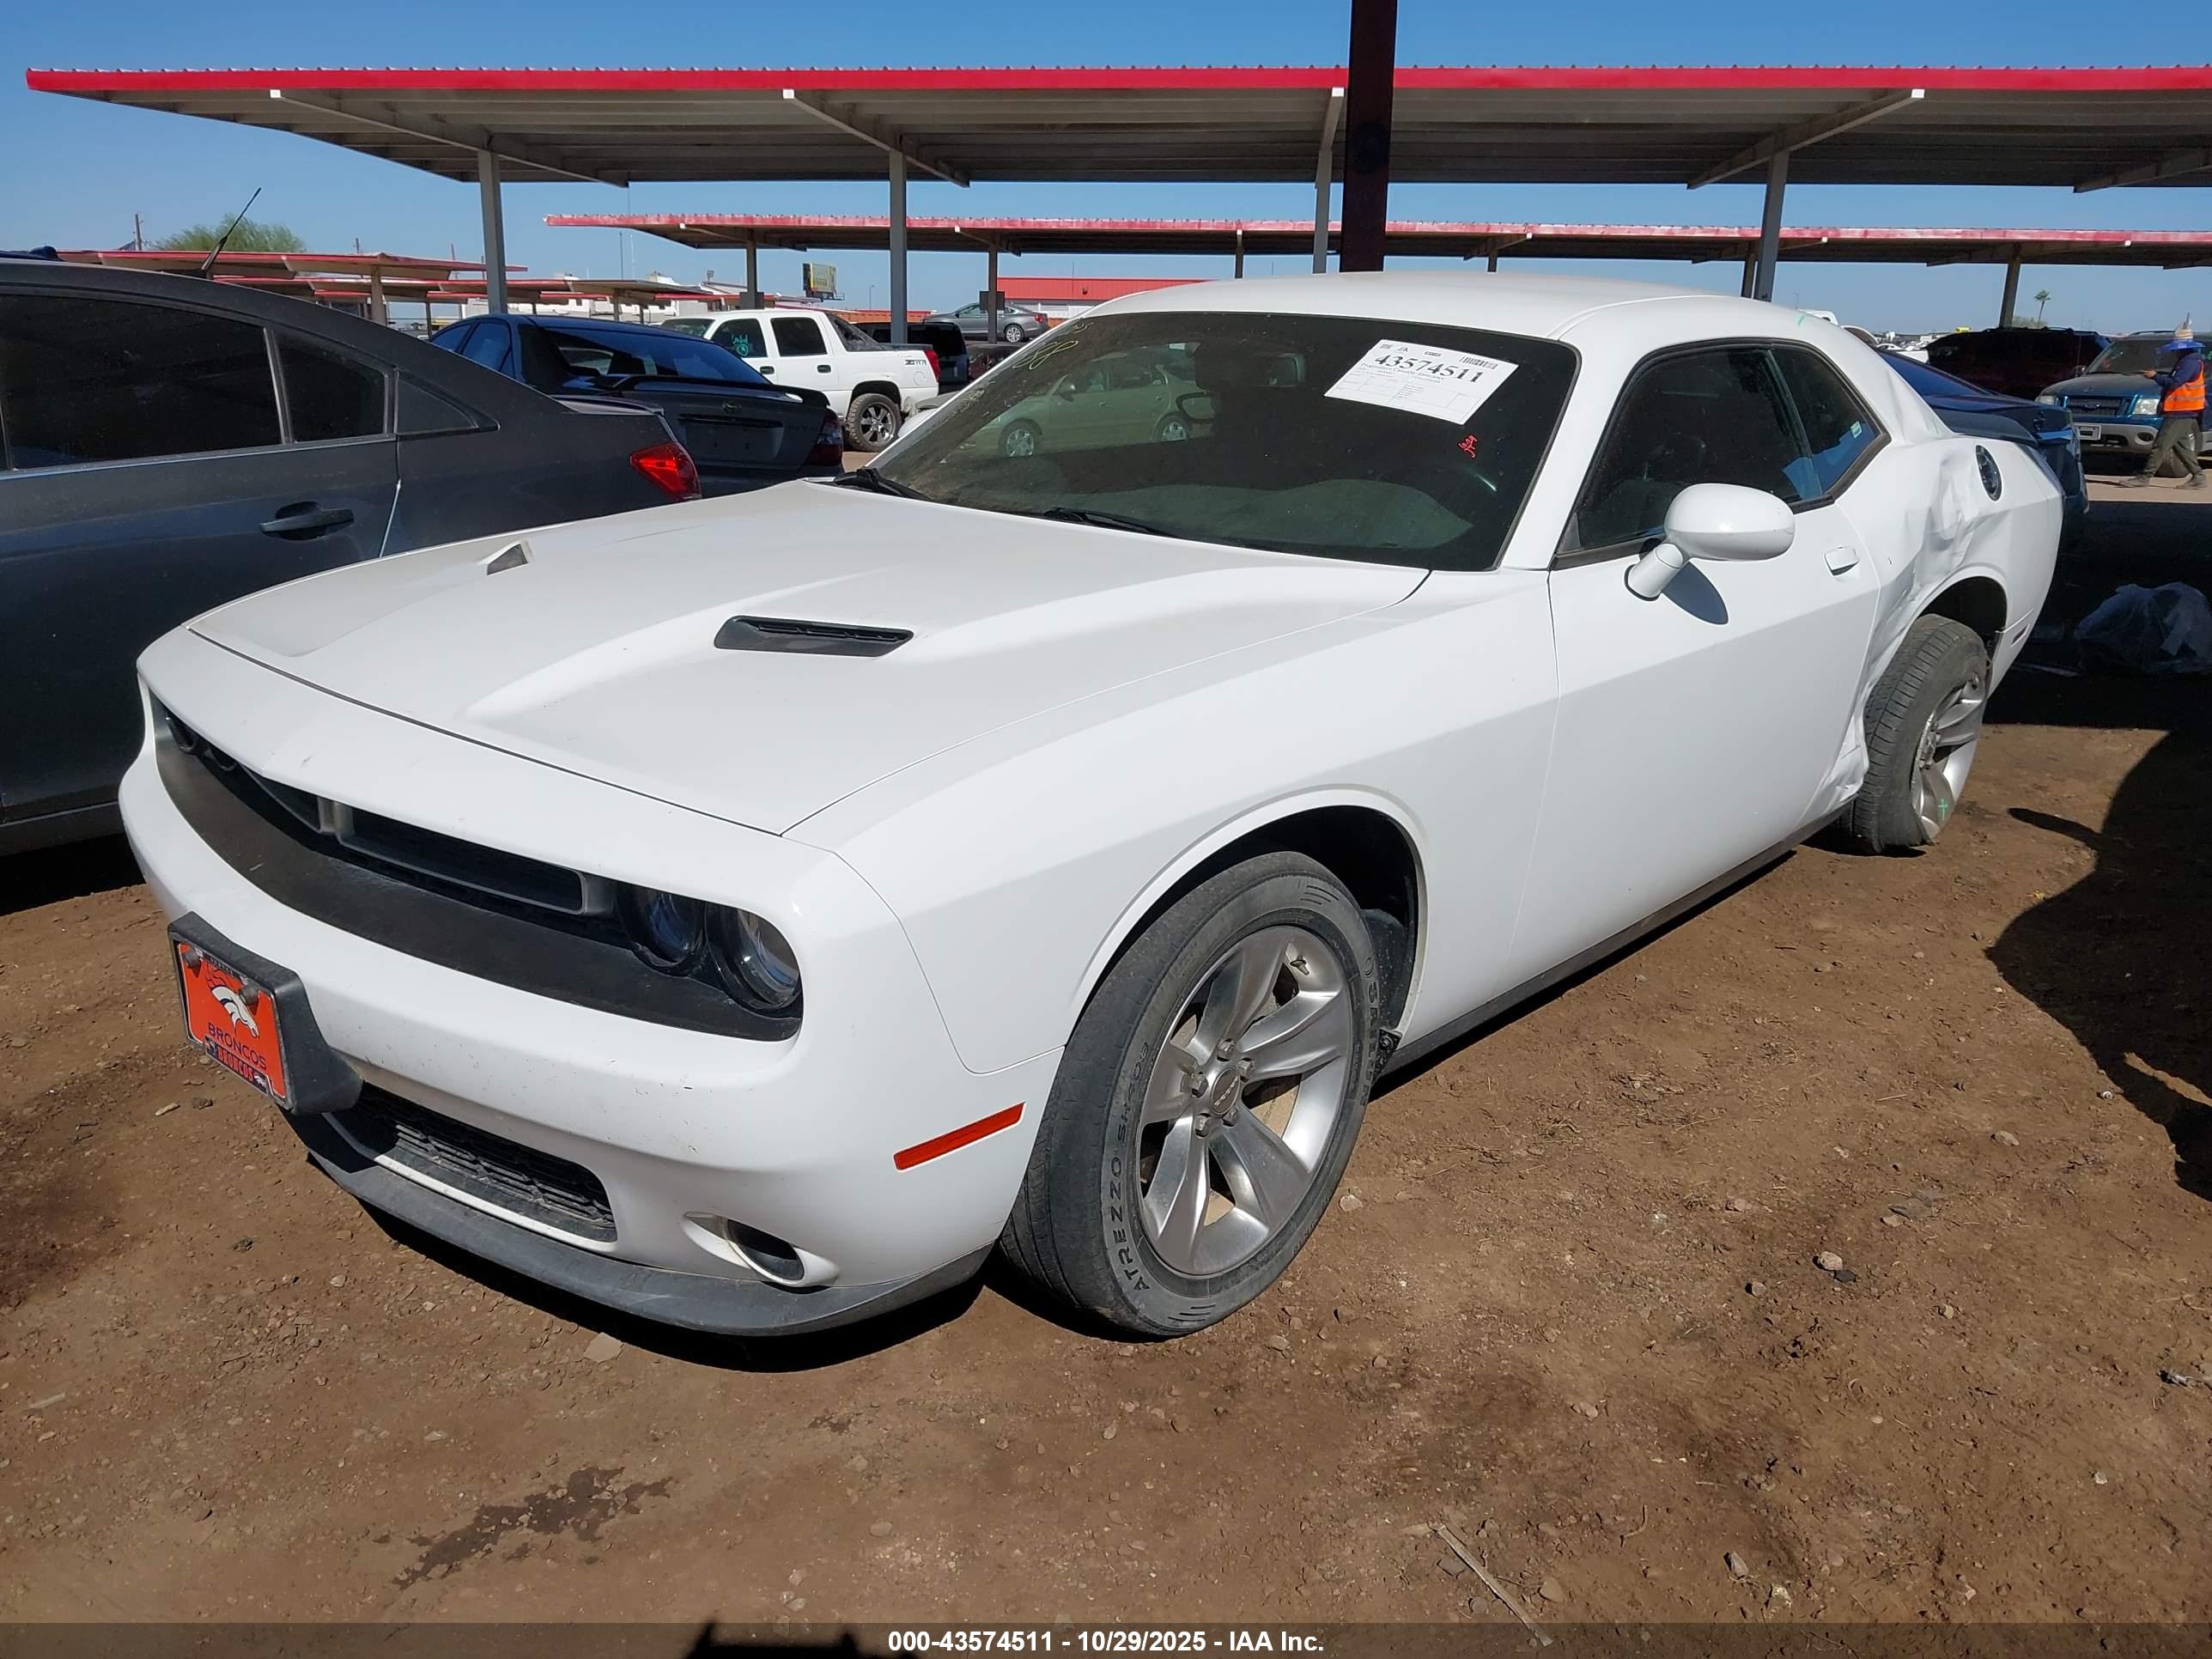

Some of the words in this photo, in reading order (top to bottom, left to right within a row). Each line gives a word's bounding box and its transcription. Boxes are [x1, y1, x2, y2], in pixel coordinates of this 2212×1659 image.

[1375, 354, 1484, 383] 43574511
[209, 1023, 266, 1071] BRONCOS
[217, 1047, 253, 1082] BRONCOS
[1110, 1157, 1152, 1291] ATREZZO
